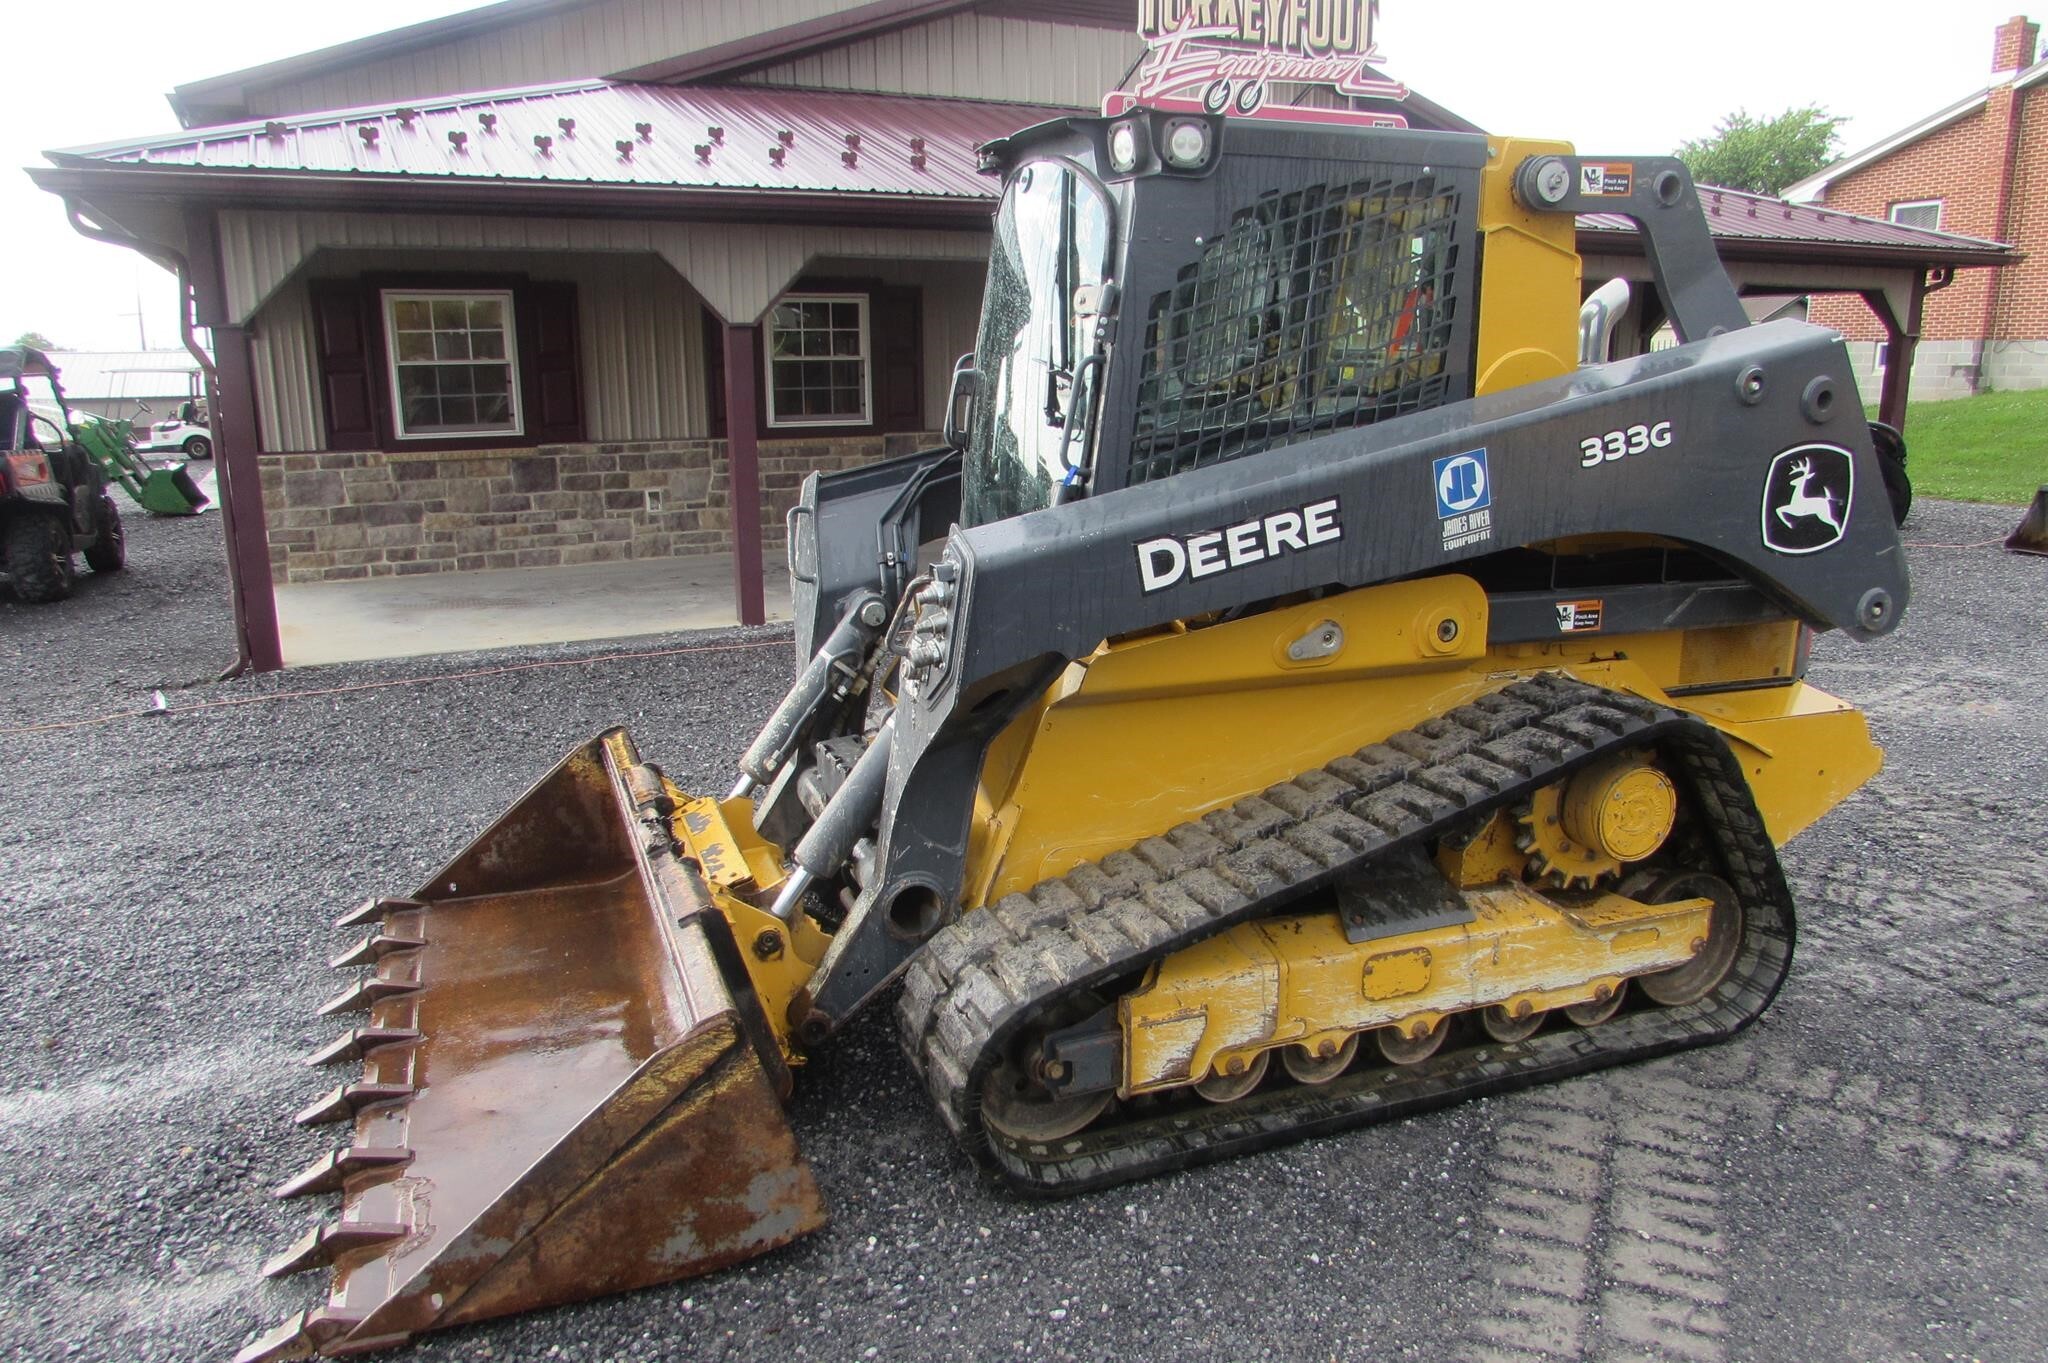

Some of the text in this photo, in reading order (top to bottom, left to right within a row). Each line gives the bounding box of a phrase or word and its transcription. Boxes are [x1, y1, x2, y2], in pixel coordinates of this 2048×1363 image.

[1143, 13, 1396, 98] Equipment
[1581, 421, 1672, 467] 333G
[1137, 500, 1341, 592] DEERE
[1442, 509, 1491, 538] JAMES RIVER
[1443, 529, 1492, 551] EQUIPMENT
